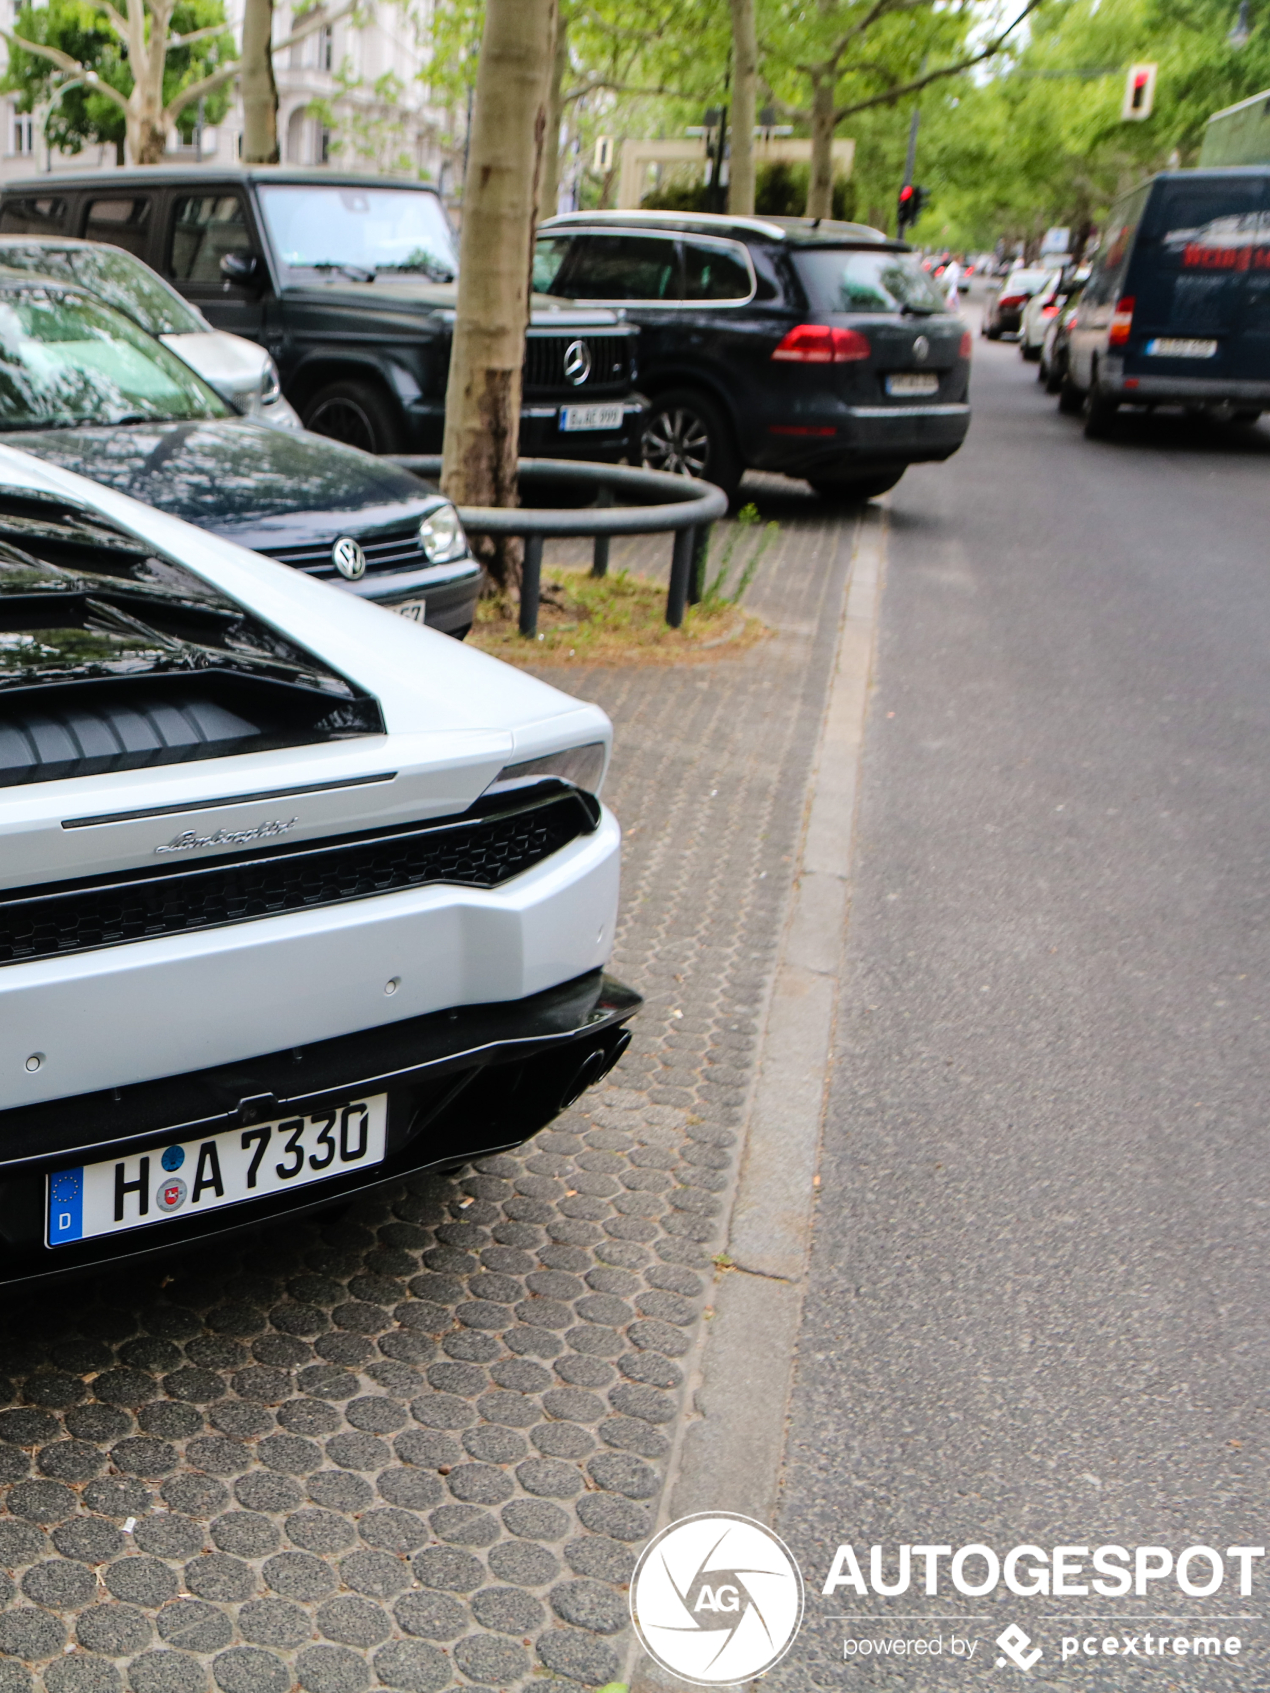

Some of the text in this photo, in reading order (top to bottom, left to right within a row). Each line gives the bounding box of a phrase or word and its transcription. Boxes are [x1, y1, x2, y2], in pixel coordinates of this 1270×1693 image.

[155, 816, 299, 854] Lamborghini
[114, 1156, 150, 1222] H
[191, 1140, 224, 1203] A
[241, 1102, 368, 1189] 7330
[58, 1212, 71, 1230] D
